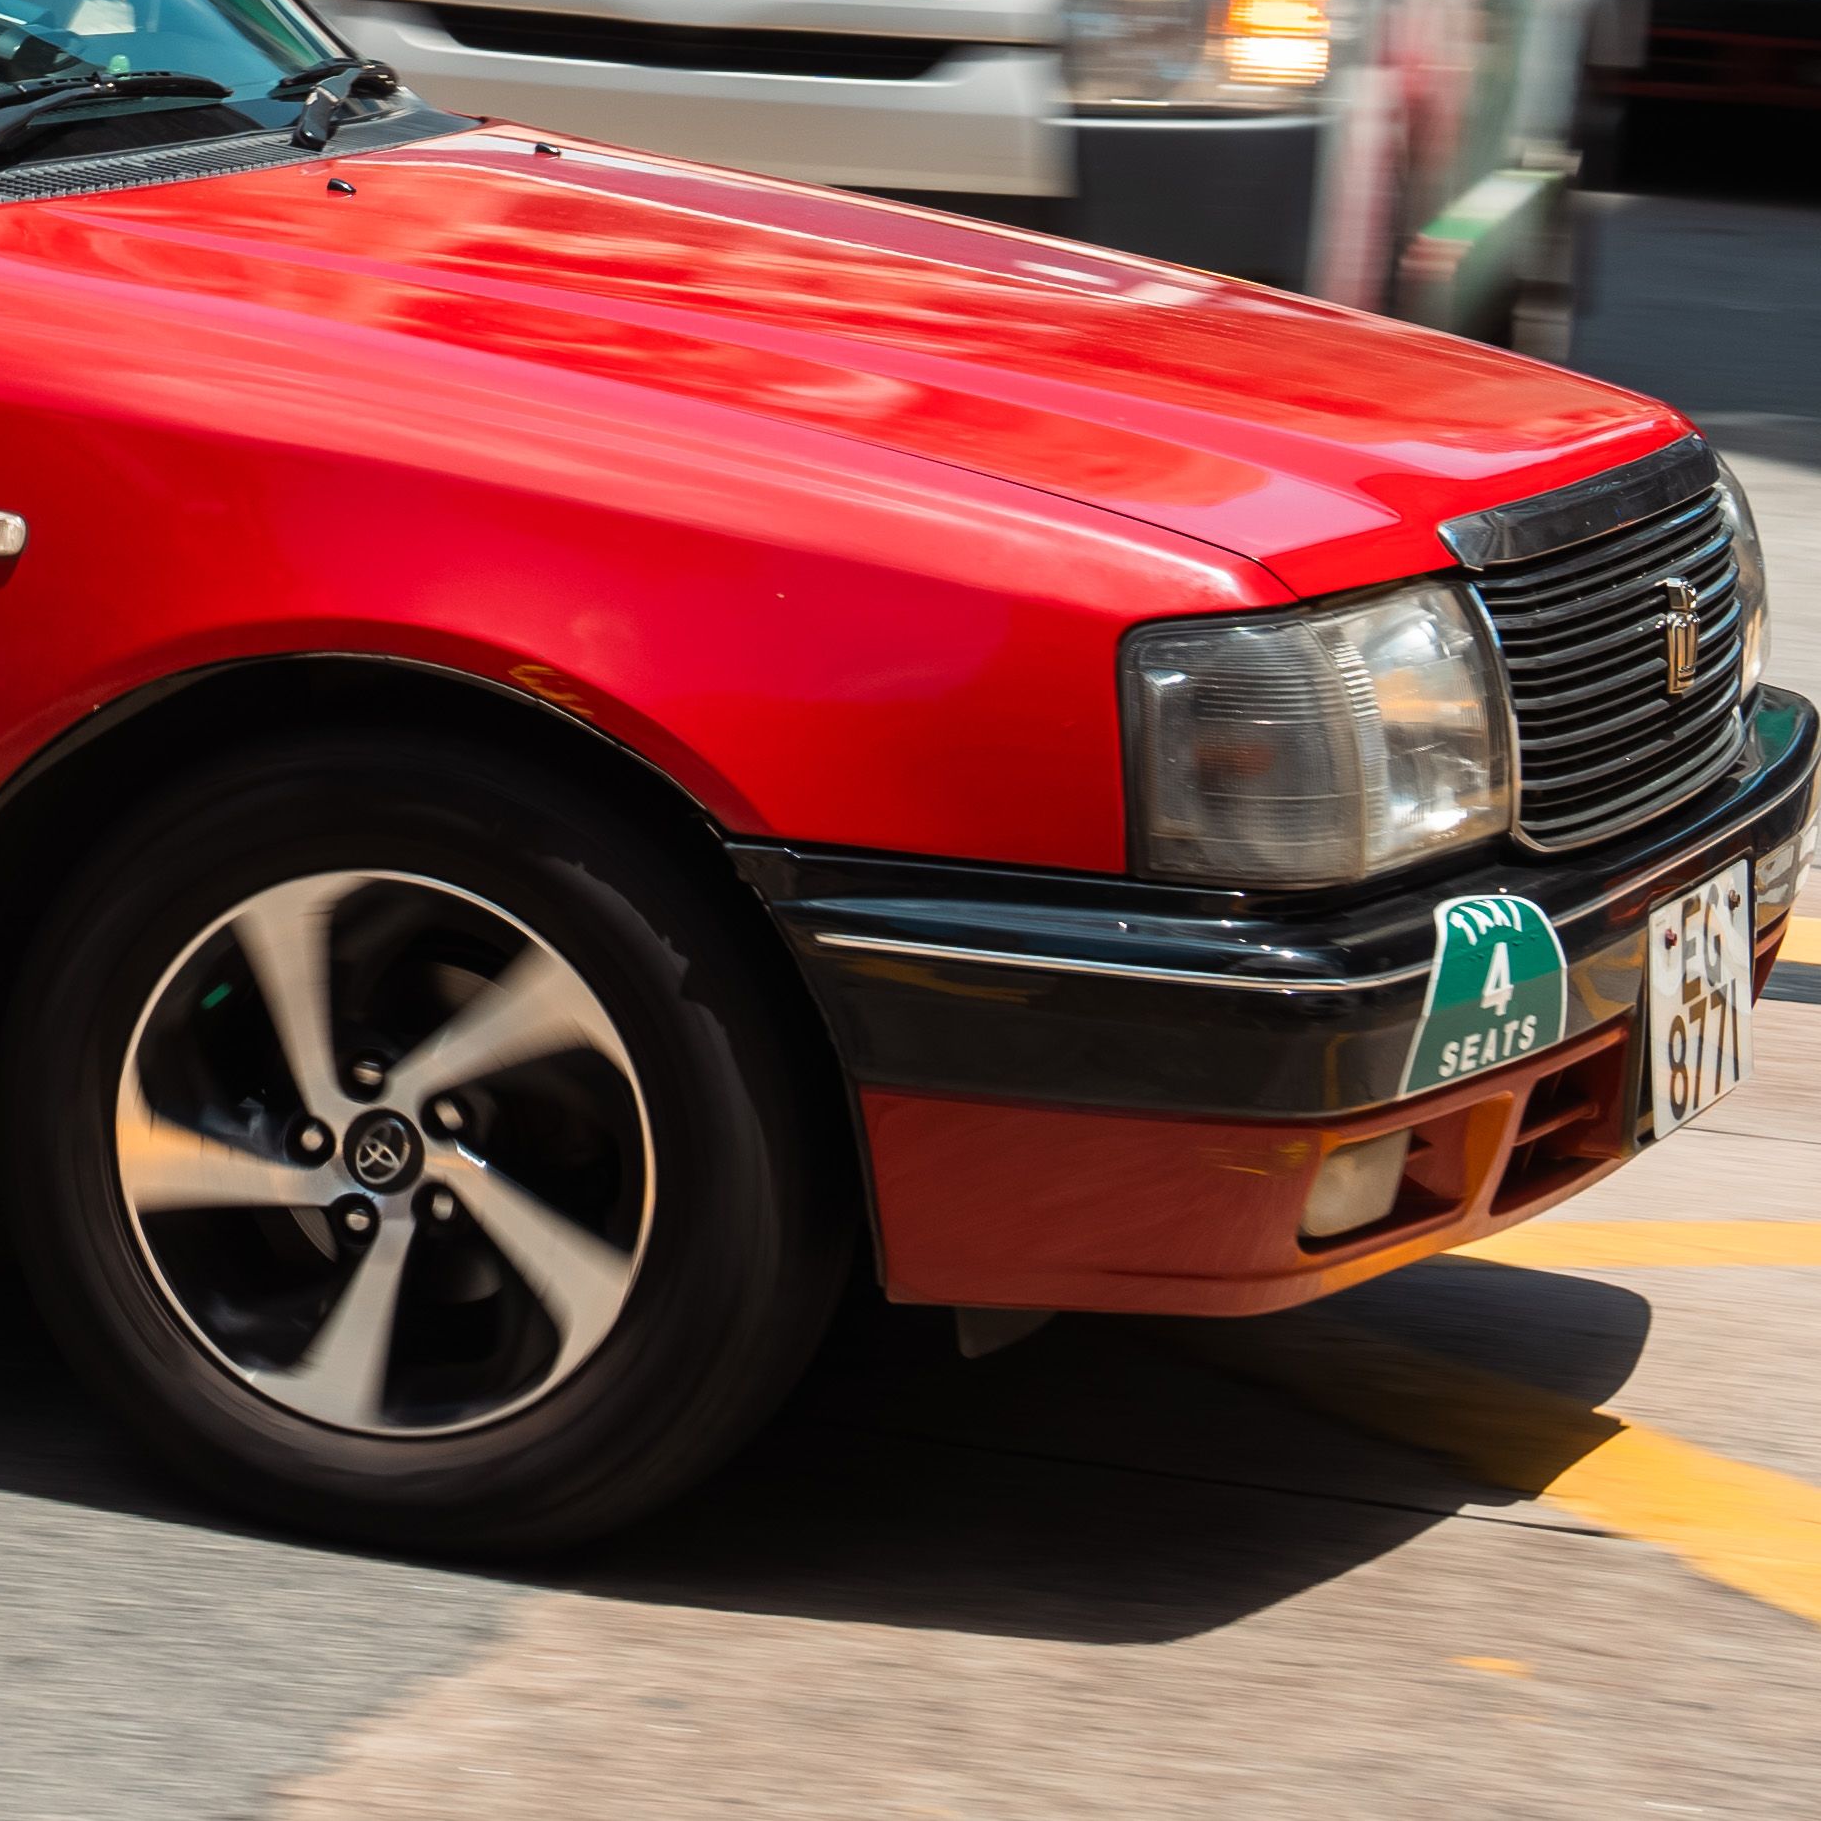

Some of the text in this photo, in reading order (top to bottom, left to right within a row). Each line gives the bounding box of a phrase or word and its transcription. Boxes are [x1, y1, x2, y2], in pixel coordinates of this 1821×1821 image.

[1449, 899, 1523, 946] TAXI
[1682, 883, 1723, 1005] EG
[1480, 942, 1515, 1016] 4
[1438, 1015, 1537, 1077] SEATS
[1668, 978, 1740, 1121] 8771
